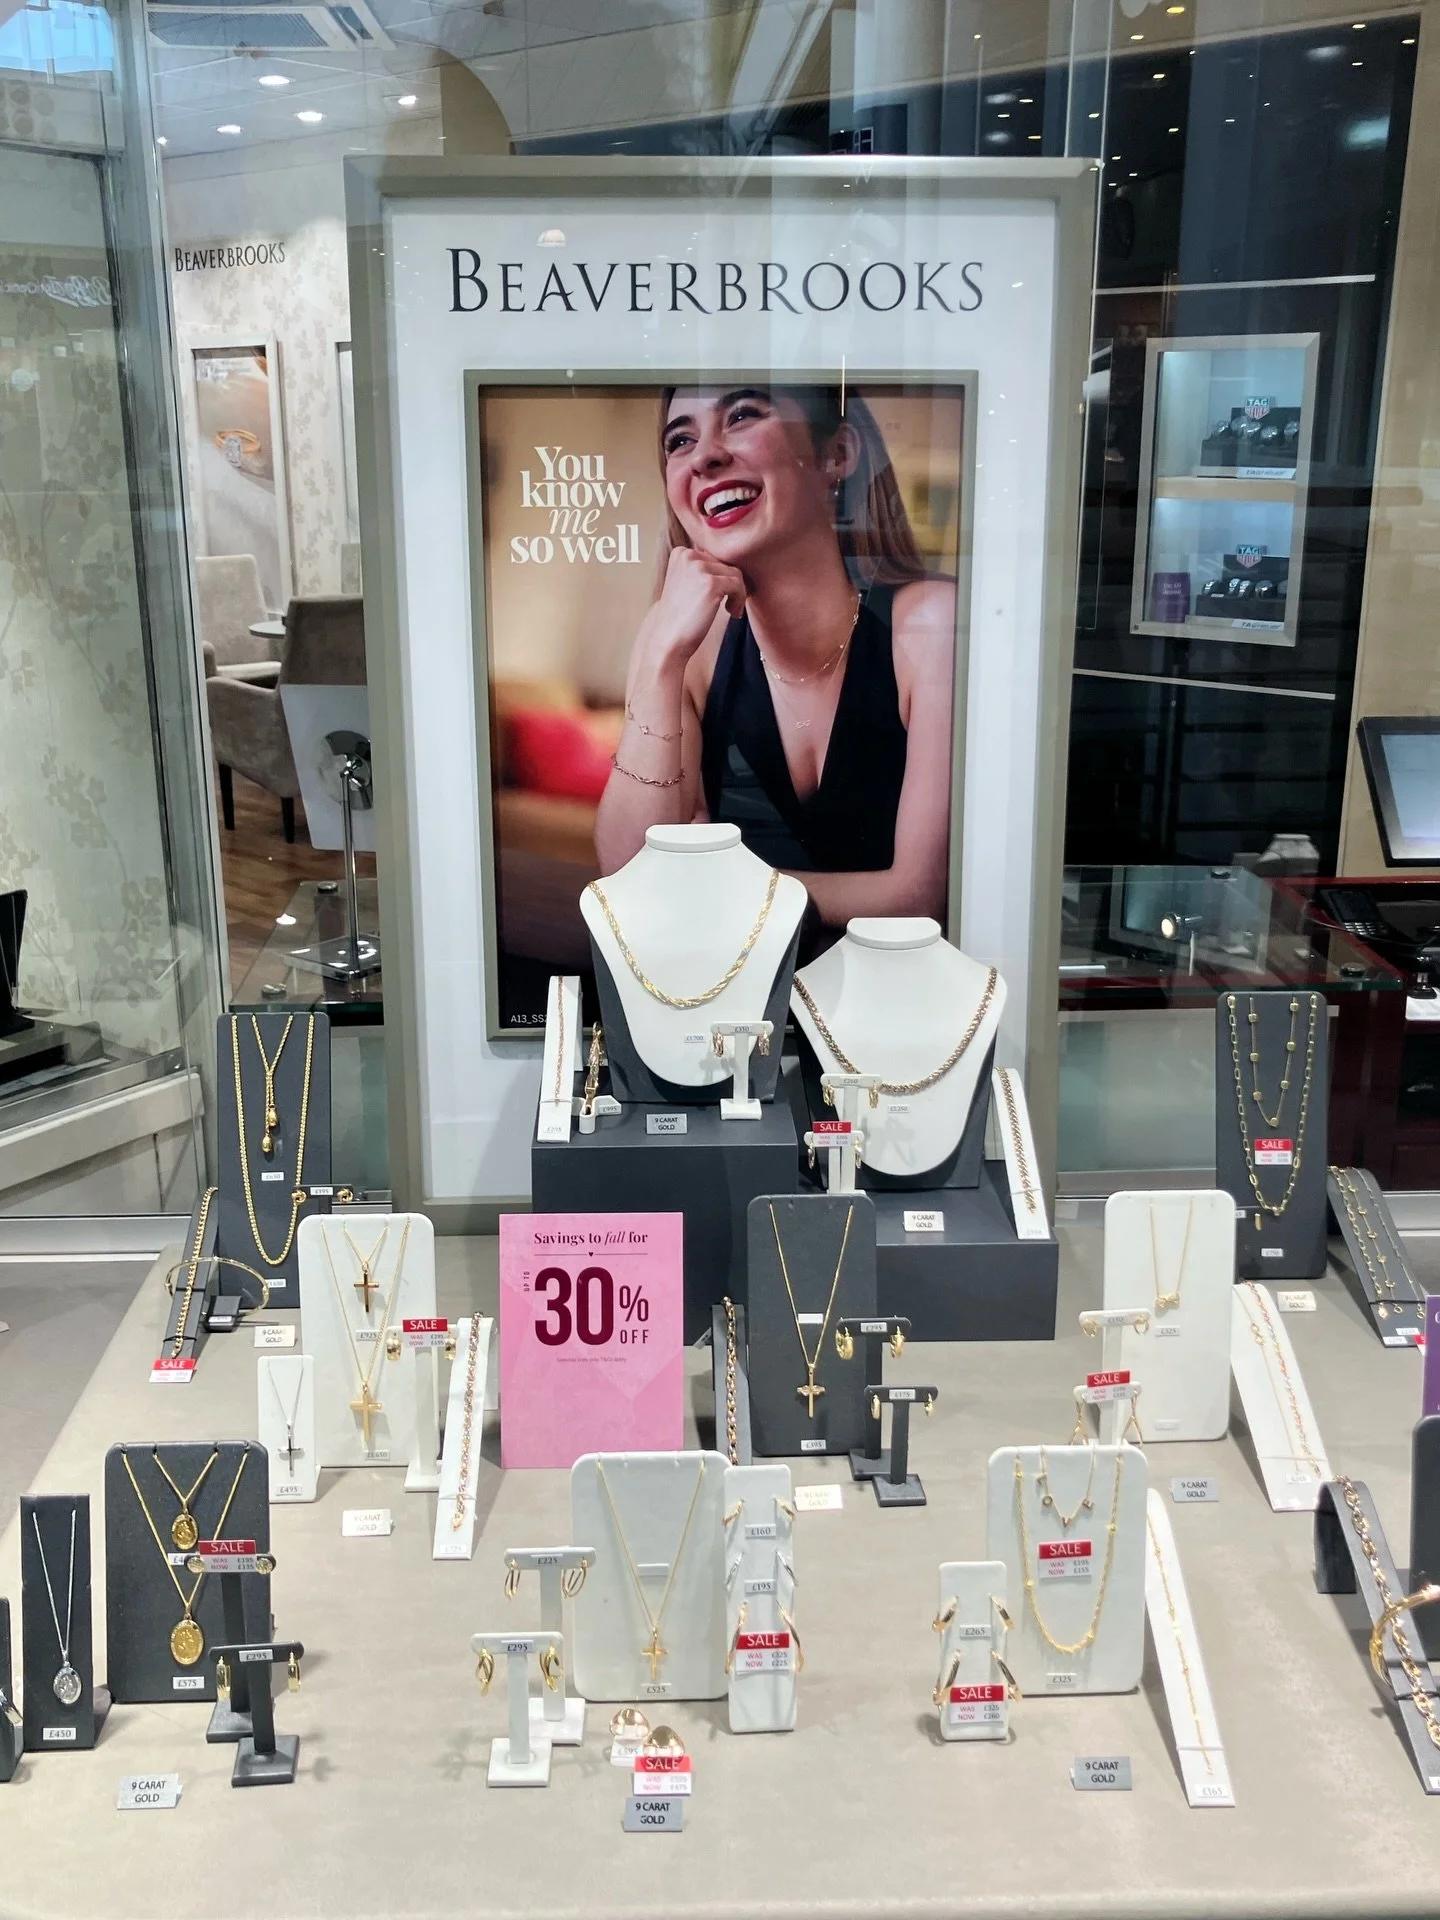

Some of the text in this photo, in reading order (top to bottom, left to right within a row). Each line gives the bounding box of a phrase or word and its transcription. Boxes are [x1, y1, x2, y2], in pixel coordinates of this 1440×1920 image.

[175, 242, 286, 272] BEAVERBROOKS
[446, 247, 984, 314] BEAVERBROOKS
[534, 446, 607, 481] You
[520, 470, 626, 508] know
[549, 508, 601, 535] me
[510, 523, 642, 564] so well
[511, 1014, 547, 1025] A13_SS
[820, 1123, 843, 1131] SALE
[1261, 1140, 1285, 1149] SALE
[534, 1231, 649, 1247] Savings to fall for
[410, 1320, 438, 1330] SALE
[619, 1329, 649, 1344] OFF
[160, 1360, 186, 1369] SALE
[1093, 1372, 1120, 1385] SALE
[279, 1485, 299, 1494] £495
[751, 1527, 771, 1536] £160
[210, 1542, 245, 1553] SALE
[1048, 1543, 1082, 1556] SALE
[752, 1581, 771, 1591] £195
[747, 1634, 780, 1648] SALE
[507, 1642, 528, 1652] £295
[177, 1679, 198, 1688] £575
[959, 1686, 992, 1700] SALE
[49, 1729, 72, 1738] £450
[645, 1757, 680, 1770] SALE
[1085, 1761, 1119, 1770] 9 CARAT
[1090, 1774, 1116, 1783] GOLD
[131, 1780, 167, 1790] 9 CARAT
[134, 1794, 160, 1803] GOLD
[635, 1802, 671, 1811] 9 CARAT
[640, 1815, 665, 1824] GOLD
